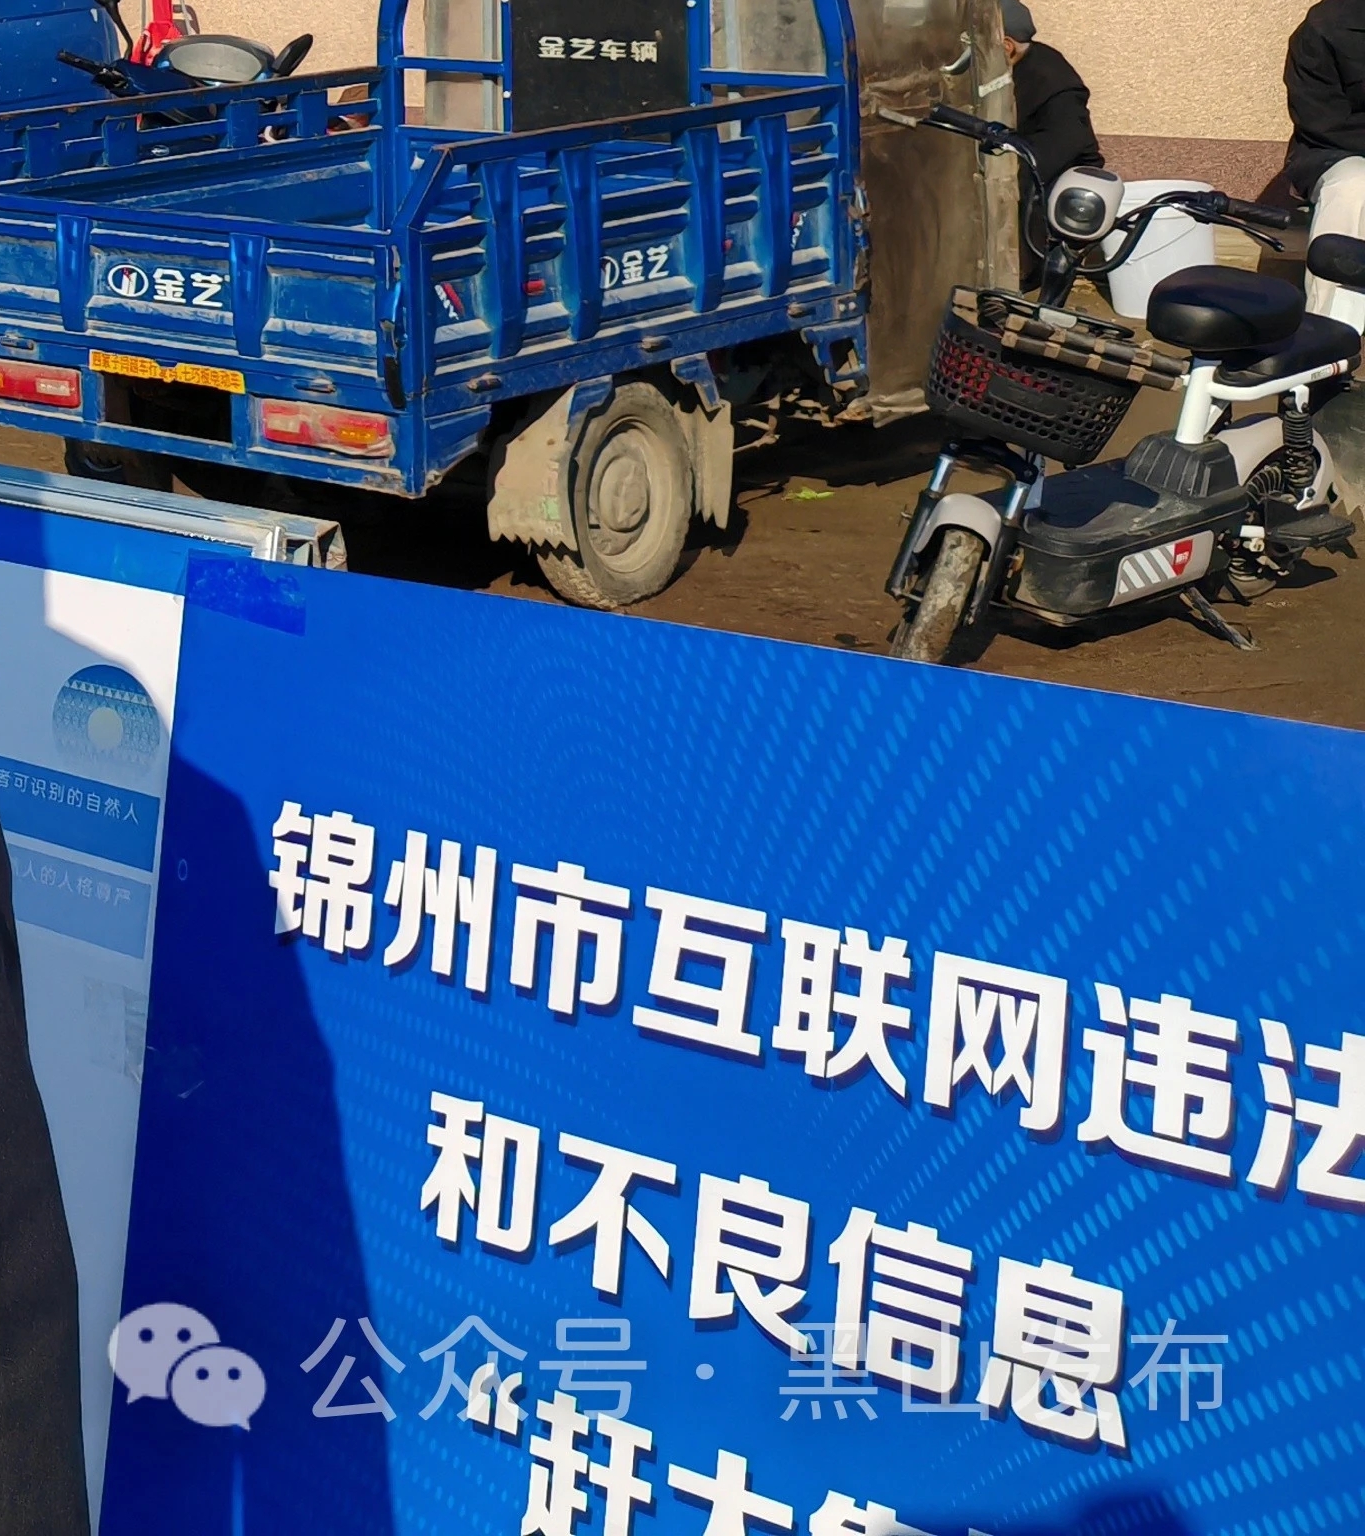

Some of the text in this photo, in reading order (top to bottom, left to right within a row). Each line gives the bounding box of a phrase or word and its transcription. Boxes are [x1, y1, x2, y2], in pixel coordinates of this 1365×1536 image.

[538, 36, 657, 63] 金艺车辆
[153, 268, 224, 307] 金艺
[621, 245, 669, 286] 金艺
[12, 858, 132, 907] 人的人格尊严
[269, 800, 1365, 1212] 锦州市互联网违法
[419, 1091, 1129, 1451] 和不良信息
